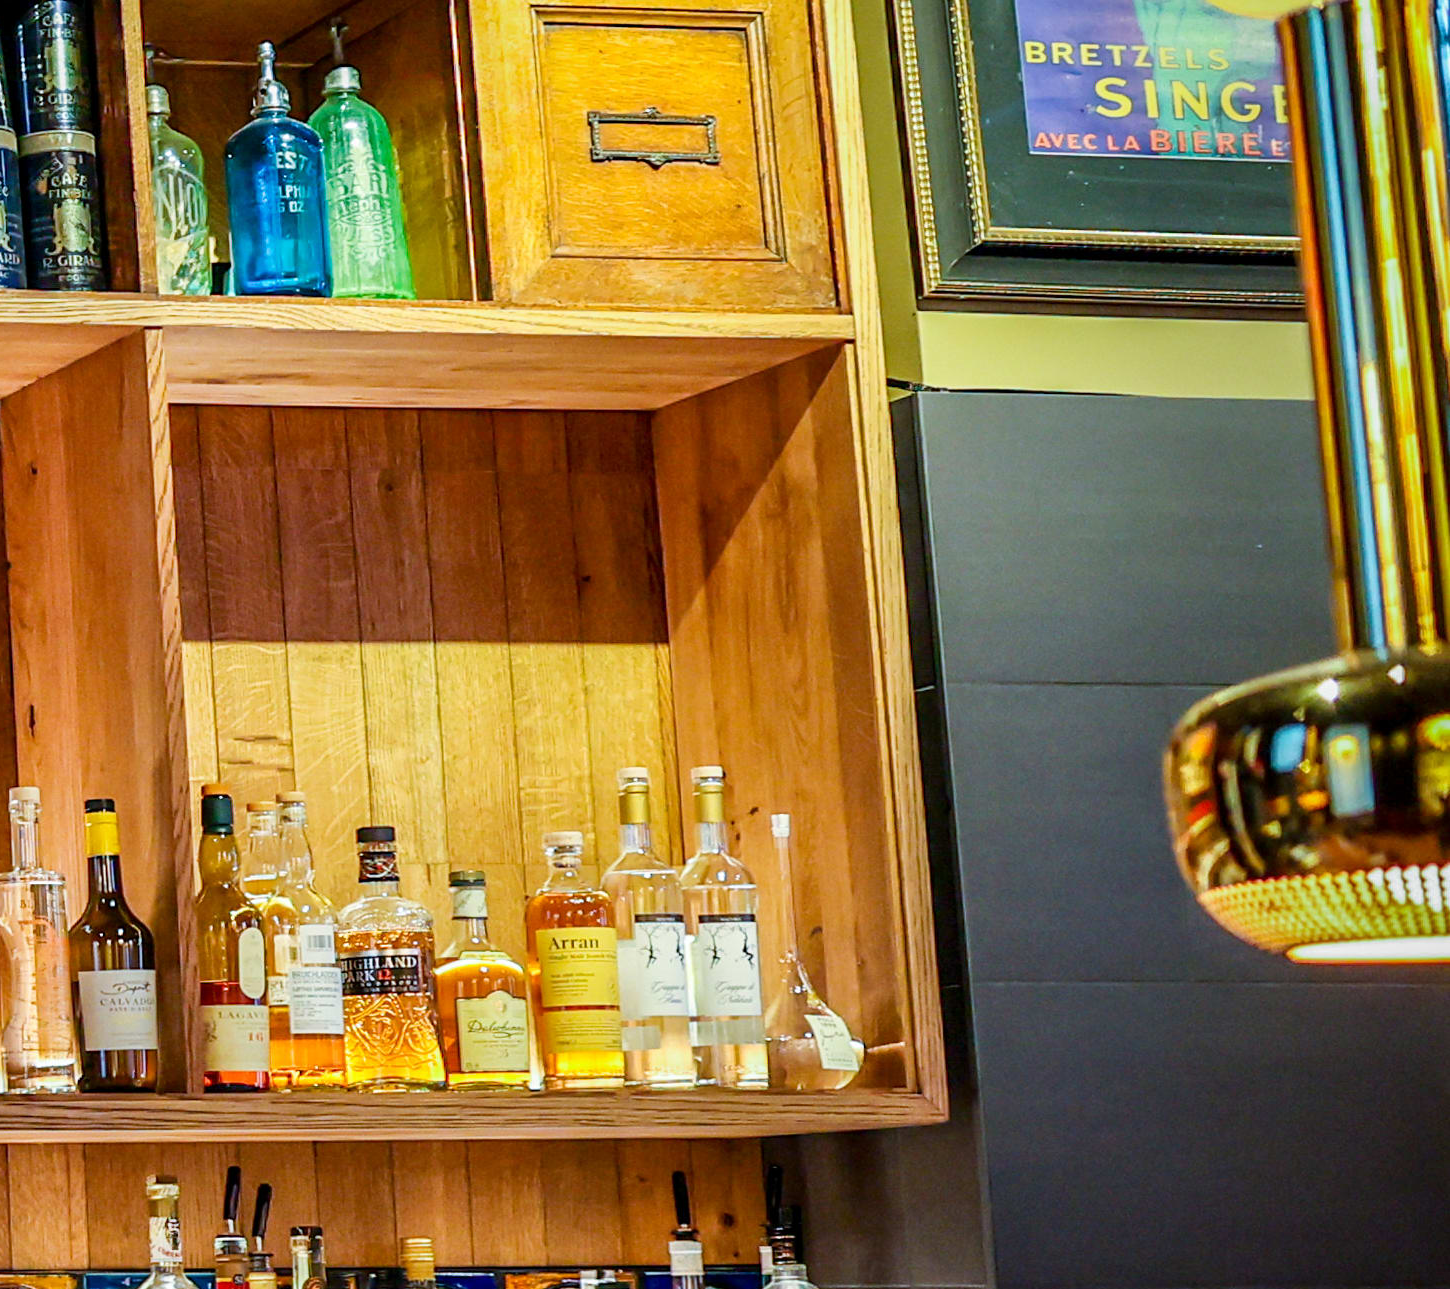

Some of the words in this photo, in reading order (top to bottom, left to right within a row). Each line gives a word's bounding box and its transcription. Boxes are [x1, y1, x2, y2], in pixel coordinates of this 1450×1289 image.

[1023, 40, 1231, 71] BRETZELS
[1034, 132, 1098, 150] AVEC
[1106, 134, 1141, 151] LA
[1149, 123, 1263, 156] BIÈRE
[547, 936, 600, 951] Arran
[247, 1032, 264, 1042] 16
